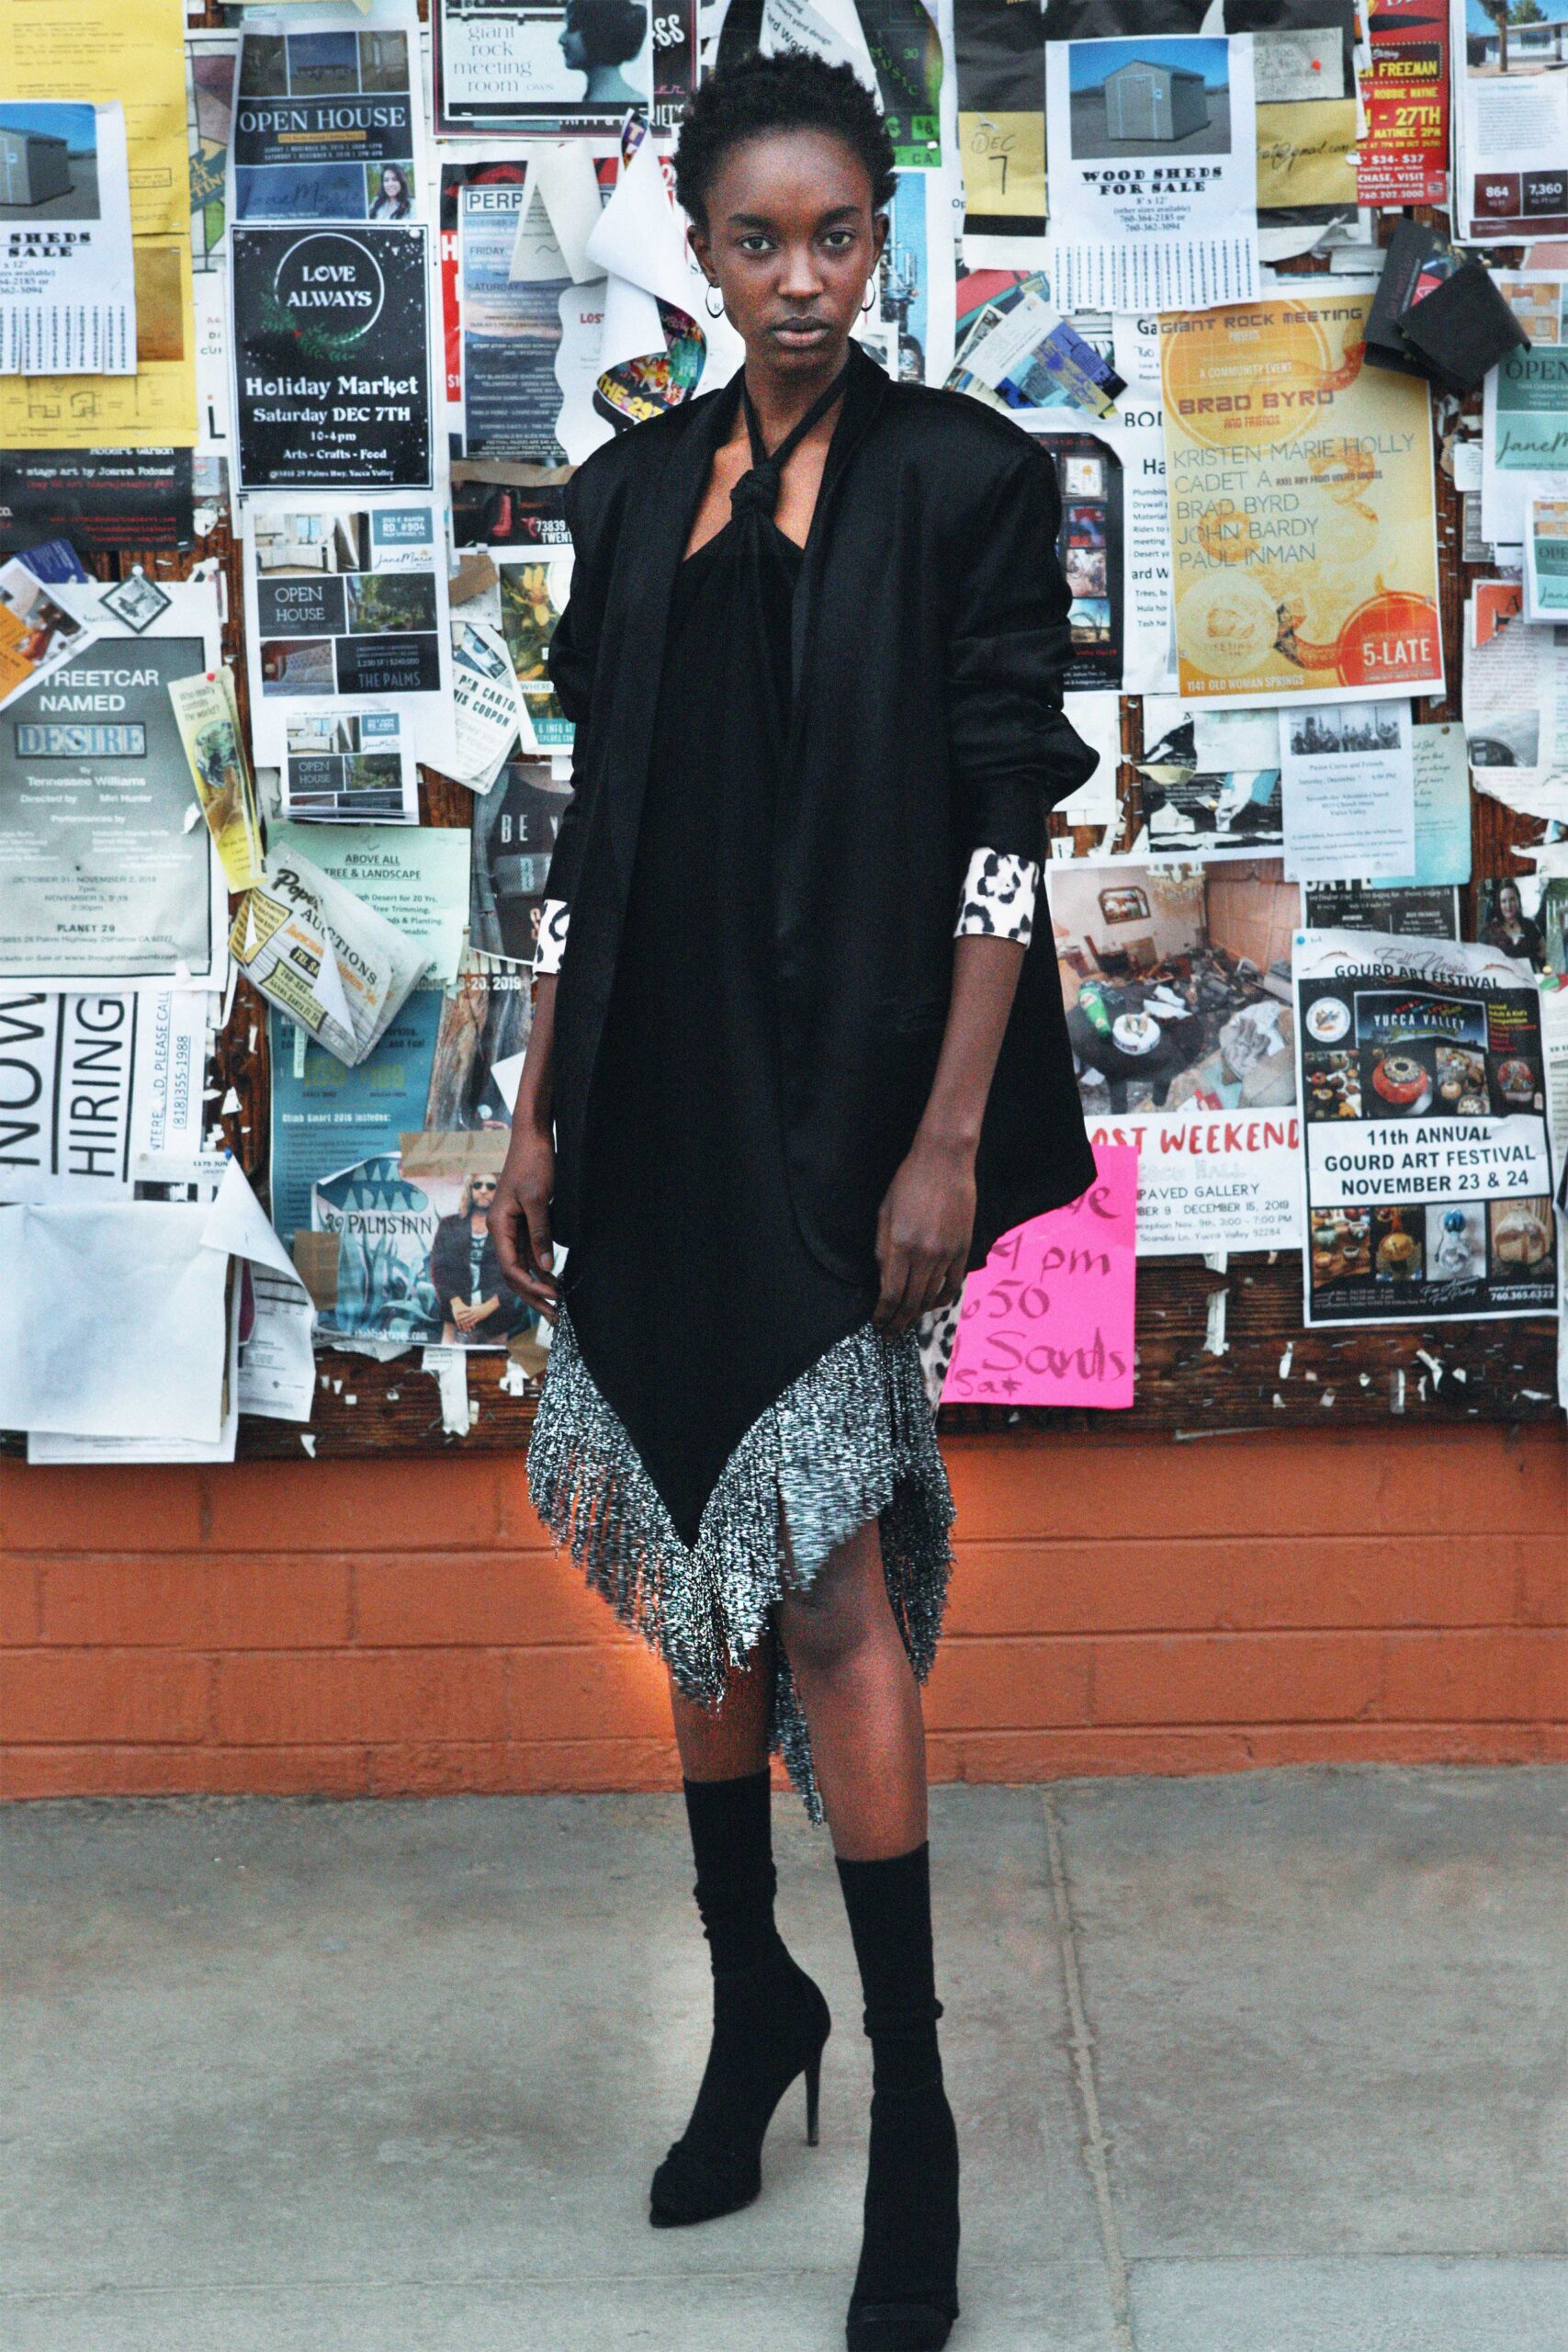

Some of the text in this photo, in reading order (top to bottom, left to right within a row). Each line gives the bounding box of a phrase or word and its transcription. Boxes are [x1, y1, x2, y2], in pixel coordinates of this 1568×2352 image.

[468, 25, 514, 40] giant
[470, 42, 514, 56] rock
[453, 61, 532, 77] meeting
[1380, 61, 1438, 77] FREEMAN
[467, 79, 519, 92] room
[239, 107, 407, 132] OPEN HOUSE
[1395, 106, 1441, 127] 27TH
[988, 154, 1009, 196] 7
[1081, 166, 1224, 182] WOOD SHEDS
[1099, 182, 1207, 196] FOR SALE
[1484, 183, 1562, 198] 864 7,360
[9, 232, 92, 244] SHEDS
[7, 245, 73, 257] SALE
[469, 246, 505, 256] FRIDAY
[301, 266, 356, 282] LOVE
[467, 282, 518, 292] SATURDAY
[286, 289, 373, 308] ALWAYS
[580, 313, 604, 324] LOS
[1159, 308, 1364, 334] GIANT ROCK MEETING
[245, 376, 419, 400] Holiday Market
[1178, 389, 1335, 415] BRAD BYRD
[253, 406, 412, 425] Saturday DEC 7TH
[310, 431, 356, 443] 10-4pm
[283, 448, 388, 459] Arts Crafts Food
[1172, 433, 1416, 469] KRISTEN MARIE HOLLY
[1174, 469, 1273, 494] CADET A
[1176, 493, 1300, 520] BRAD BYRD
[536, 520, 566, 532] 73839
[1178, 517, 1320, 546] JOHN BARDY
[1134, 537, 1166, 547] meeting
[1134, 550, 1159, 559] Desert
[1179, 544, 1317, 571] PAUL INMAN
[275, 586, 322, 603] OPEN
[276, 607, 326, 622] HOUSE
[1362, 638, 1433, 667] 5-LATE
[43, 670, 160, 687] TREETCAR
[358, 672, 421, 687] THE PALMS
[39, 695, 126, 712] NAMED
[471, 701, 511, 728] COUPON
[21, 727, 143, 753] DESIRE
[299, 761, 330, 773] OPEN
[27, 775, 146, 786] Tennessee Williams
[299, 774, 331, 785] HOUSE
[19, 794, 78, 805] Directed by
[500, 814, 530, 844] BE
[344, 854, 400, 865] ABOVE ALL
[351, 868, 360, 878] &
[362, 869, 422, 880] LANDSCAPE
[371, 894, 398, 902] Desert
[399, 894, 411, 902] for
[373, 905, 390, 913] Tree
[56, 923, 97, 933] PLANET
[493, 976, 523, 990] 2019
[1334, 964, 1502, 989] GOURD ART FESTIVAL
[1374, 1013, 1466, 1031] YUCCA VALLEY
[154, 1024, 169, 1071] PLEASE
[0, 992, 47, 1167] NOW
[68, 997, 125, 1177] HIRING
[172, 1035, 189, 1130] (818)355-1988
[1367, 1126, 1493, 1146] 11th ANNUAL
[1325, 1145, 1537, 1171] GOURD ART FESTIVAL
[1341, 1170, 1529, 1196] NOVEMBER 23 & 24
[1137, 1183, 1260, 1201] PAVED GALLERY
[1183, 1201, 1290, 1215] DECEMBER 2019
[348, 1215, 433, 1235] PALMS INN
